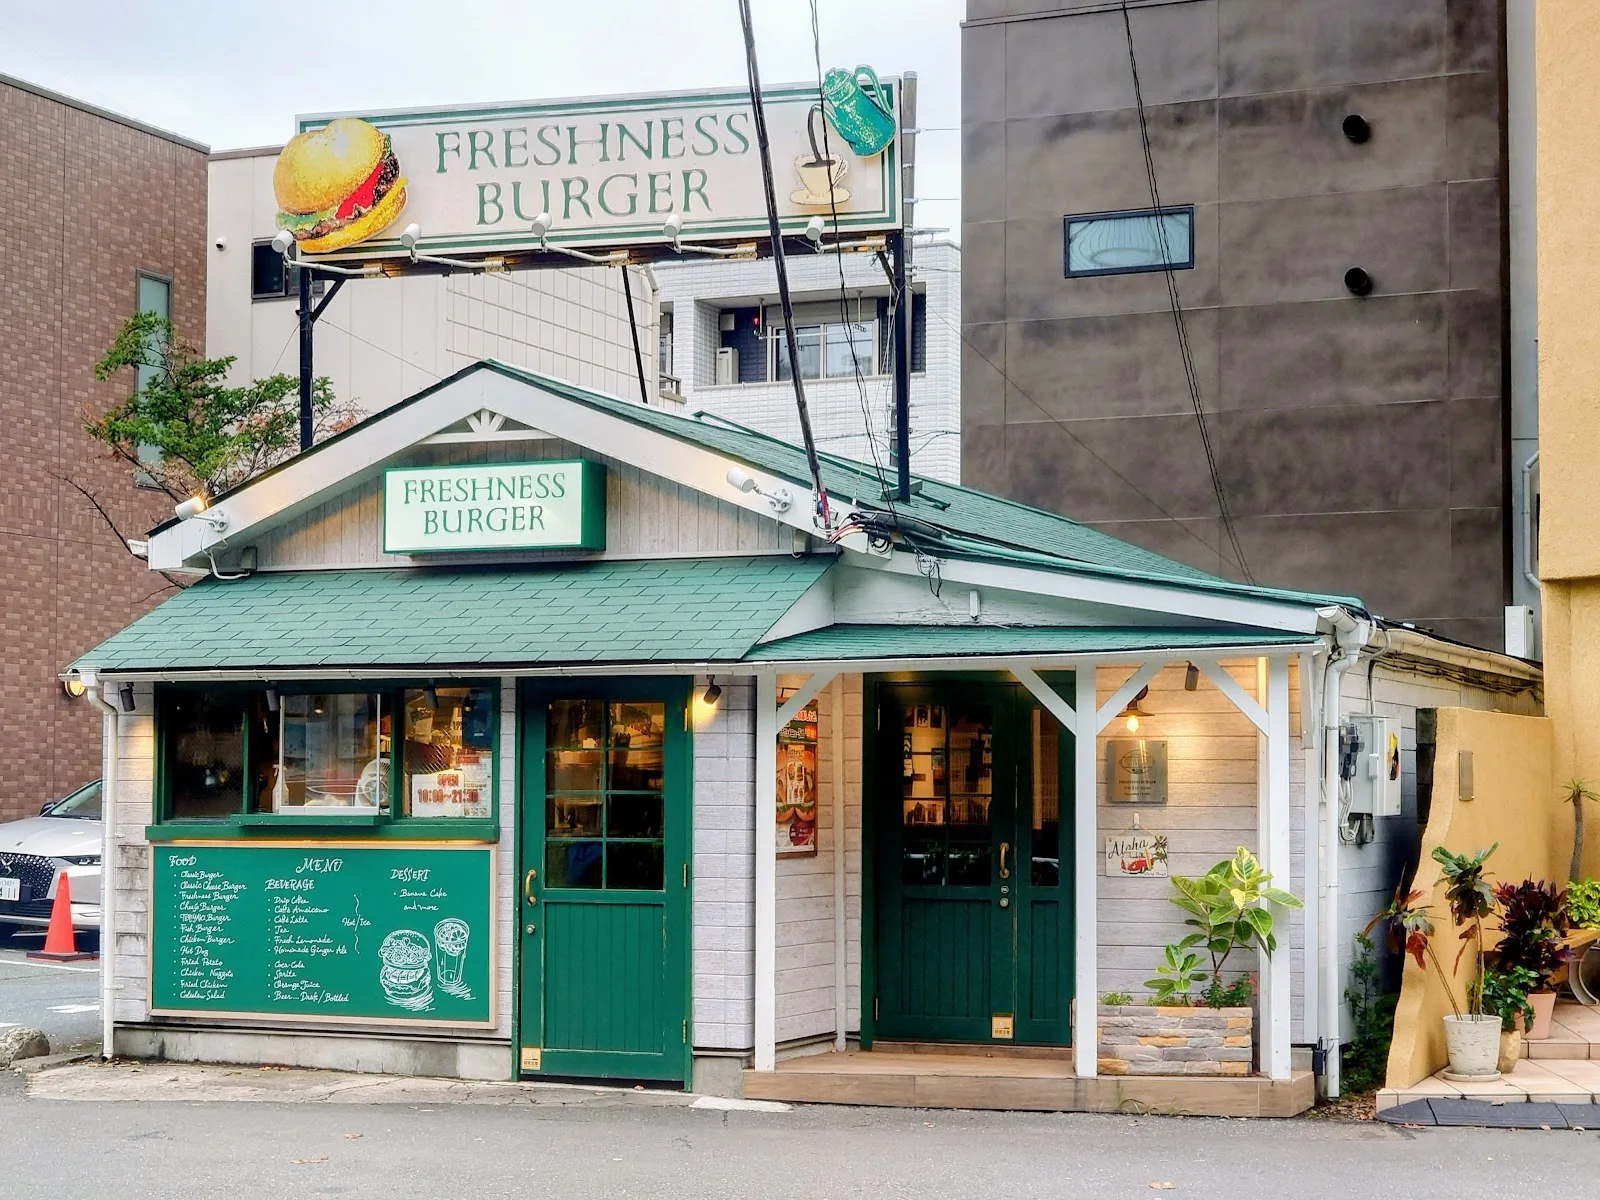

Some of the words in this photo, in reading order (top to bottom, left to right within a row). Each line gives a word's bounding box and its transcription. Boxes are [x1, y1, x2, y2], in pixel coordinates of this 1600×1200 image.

[435, 112, 750, 174] FRESHNESS
[476, 168, 714, 226] BURGER
[403, 472, 566, 505] FRESHNESS
[423, 505, 546, 535] BURGER
[1108, 837, 1149, 859] Aloha
[169, 855, 197, 867] FOOD
[296, 858, 343, 874] MENU
[197, 871, 224, 881] Burger
[390, 867, 431, 882] DESSERT
[220, 881, 247, 893] Burger
[265, 878, 315, 891] BEVERAGE
[179, 890, 211, 900] Freshness
[211, 891, 239, 902] Burger
[430, 887, 448, 898] Cake
[273, 896, 290, 905] Drip
[404, 900, 417, 911] and
[198, 902, 227, 913] Burger
[205, 913, 231, 925] Burger
[180, 923, 194, 933] Fish
[194, 924, 224, 935] Burger
[274, 925, 289, 934] Tea
[180, 934, 206, 943] Chicken
[205, 935, 235, 946] Burger
[274, 934, 295, 944] Fresh
[295, 934, 333, 944] Lemonade
[180, 945, 193, 955] Hot
[194, 945, 209, 957] Dog
[274, 945, 309, 954] Homemade
[310, 945, 335, 956] Ginger
[180, 956, 199, 966] Fried
[201, 957, 223, 966] Potato
[180, 967, 204, 976] Chicken
[209, 968, 233, 980] Nuggets
[274, 969, 297, 980] Sprite
[180, 979, 199, 988] Fried
[199, 979, 228, 988] Chicken
[273, 980, 300, 990] Orange
[300, 980, 321, 990] Juice
[205, 989, 225, 1001] Salad
